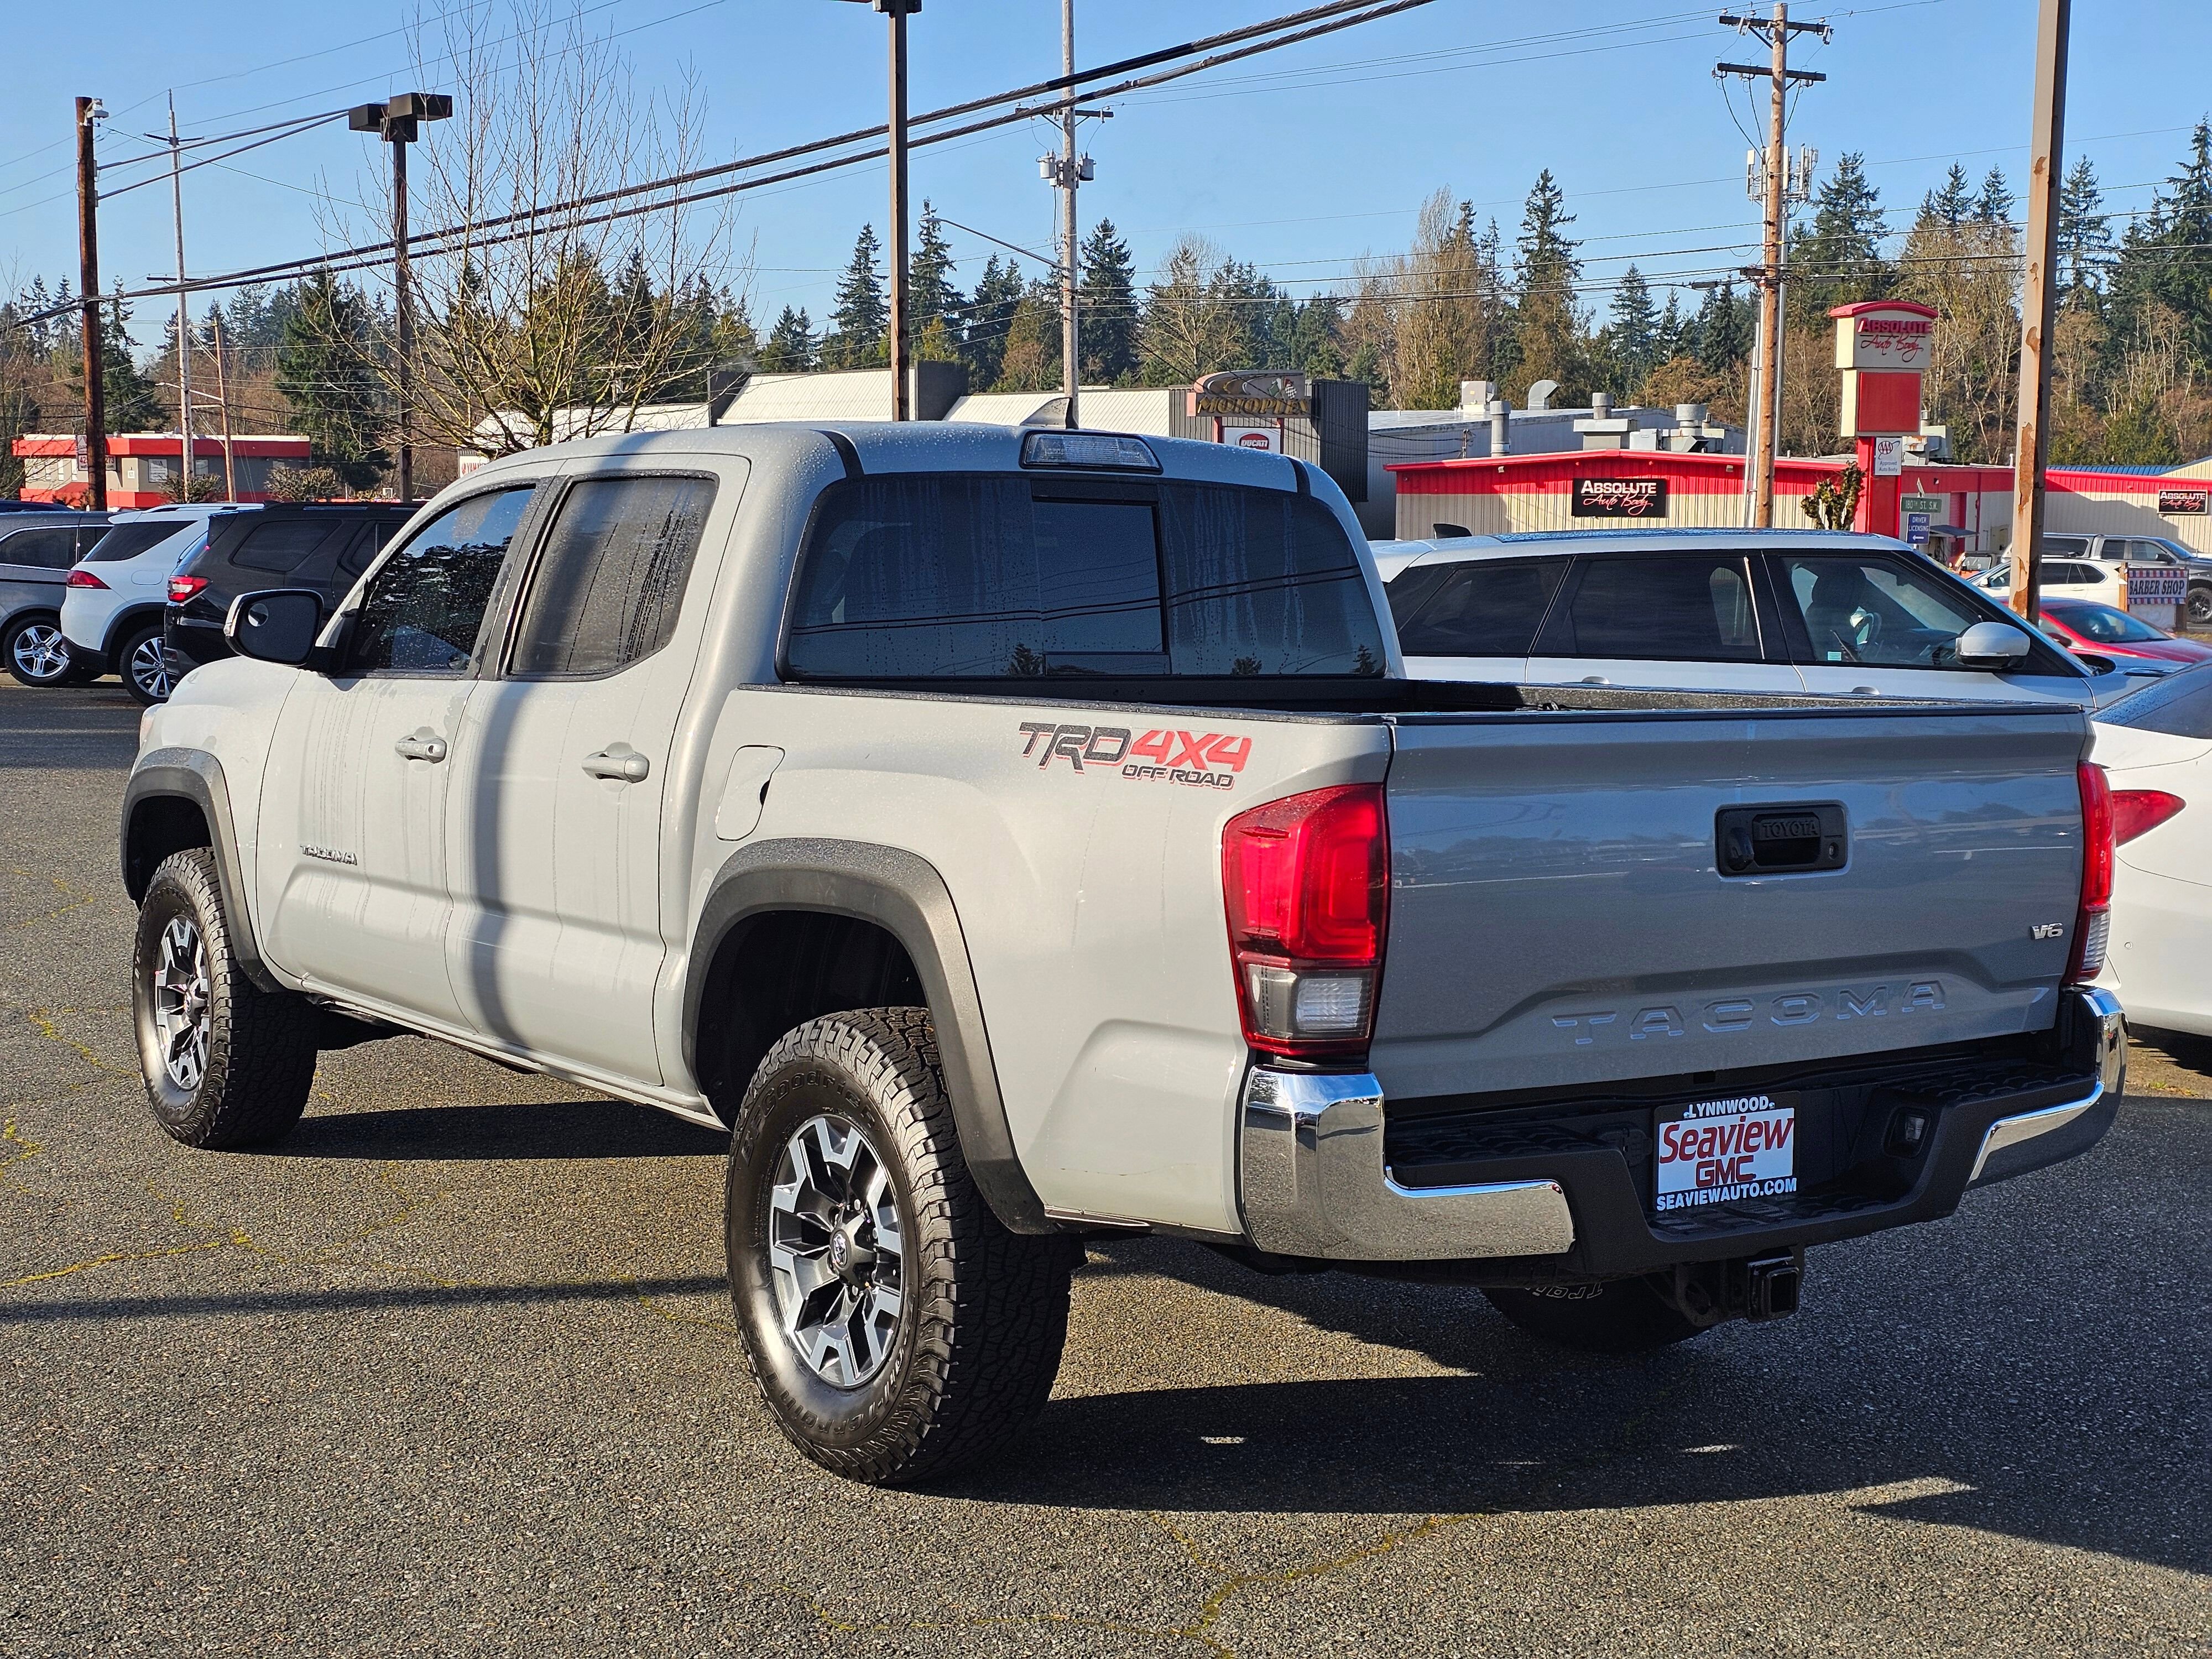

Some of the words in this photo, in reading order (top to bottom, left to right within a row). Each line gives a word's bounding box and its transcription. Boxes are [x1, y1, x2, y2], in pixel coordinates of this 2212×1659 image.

[1858, 317, 1933, 333] ABSOLUTE
[1861, 335, 1895, 356] Auto
[1894, 333, 1924, 362] Body
[1197, 397, 1310, 415] MOTOPLEX
[1580, 480, 1657, 494] ABSOLUTE
[2160, 492, 2206, 500] ABSOLUTE
[1583, 494, 1623, 510] Auto
[1621, 489, 1654, 515] Body
[2129, 580, 2160, 595] BARBER
[2161, 580, 2185, 595] SHOP
[1019, 722, 1133, 774] TRD
[1122, 764, 1168, 782] OFF
[1168, 769, 1235, 790] ROAD
[1762, 820, 1819, 838] TOYOTA
[2031, 922, 2063, 940] V6
[1551, 979, 1946, 1045] TACOMA
[1688, 1095, 1770, 1118] LYNNWOOD
[1660, 1115, 1794, 1164] Seaview
[1695, 1155, 1757, 1187] GMC
[1657, 1178, 1797, 1211] SEAVIEWAUTO.COM
